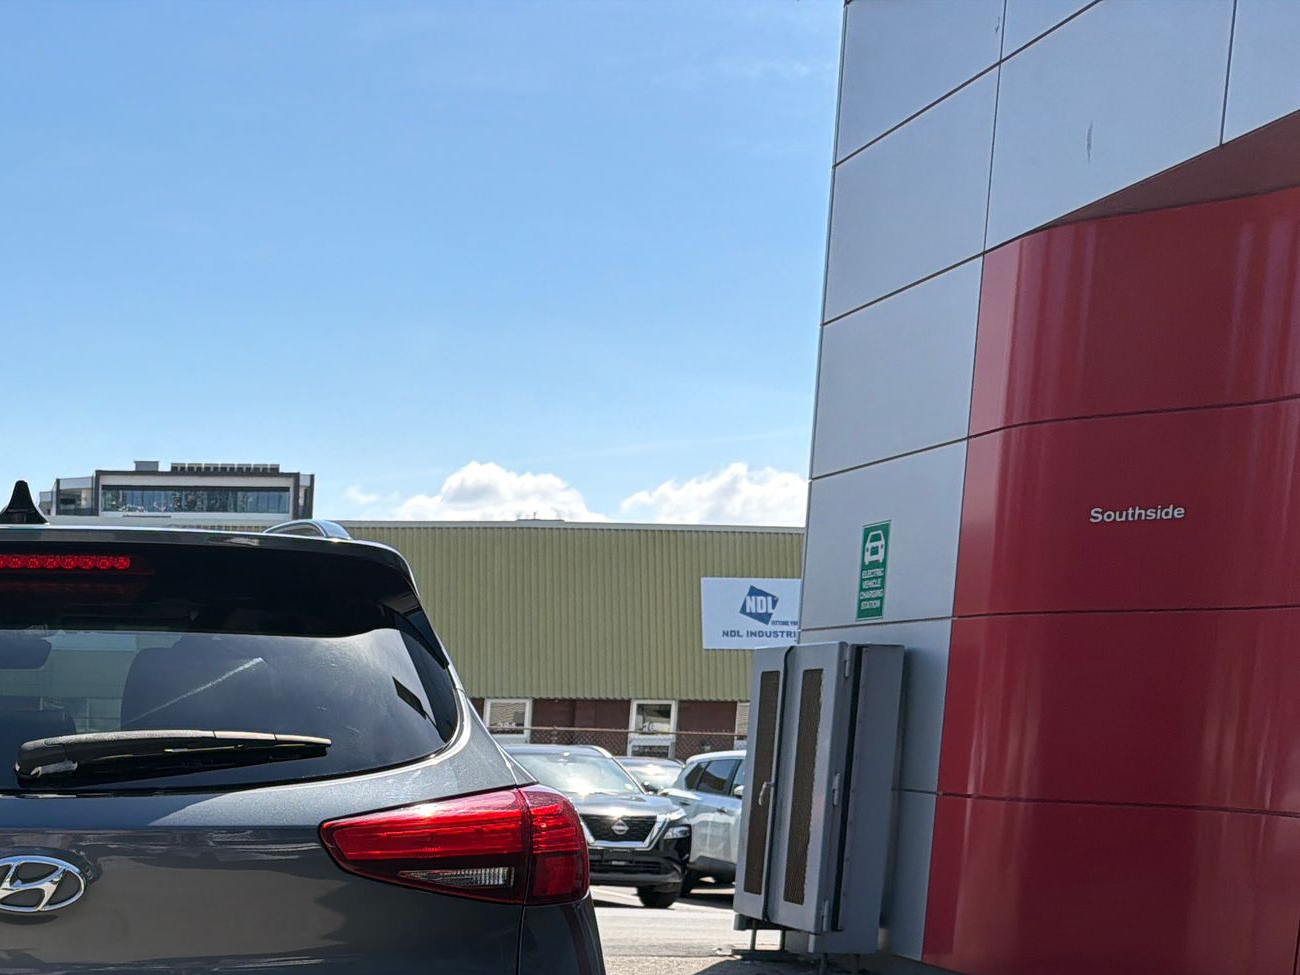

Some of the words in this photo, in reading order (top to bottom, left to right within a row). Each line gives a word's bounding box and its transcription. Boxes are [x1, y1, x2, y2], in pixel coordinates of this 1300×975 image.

[1090, 504, 1185, 523] Southside
[861, 567, 884, 579] ELECTRIC
[862, 578, 881, 589] VEHICLE
[859, 588, 884, 600] CHARGING
[745, 596, 774, 613] NDL
[860, 599, 881, 610] STATION
[722, 630, 743, 638] NDL
[746, 630, 796, 639] INDUSTRI
